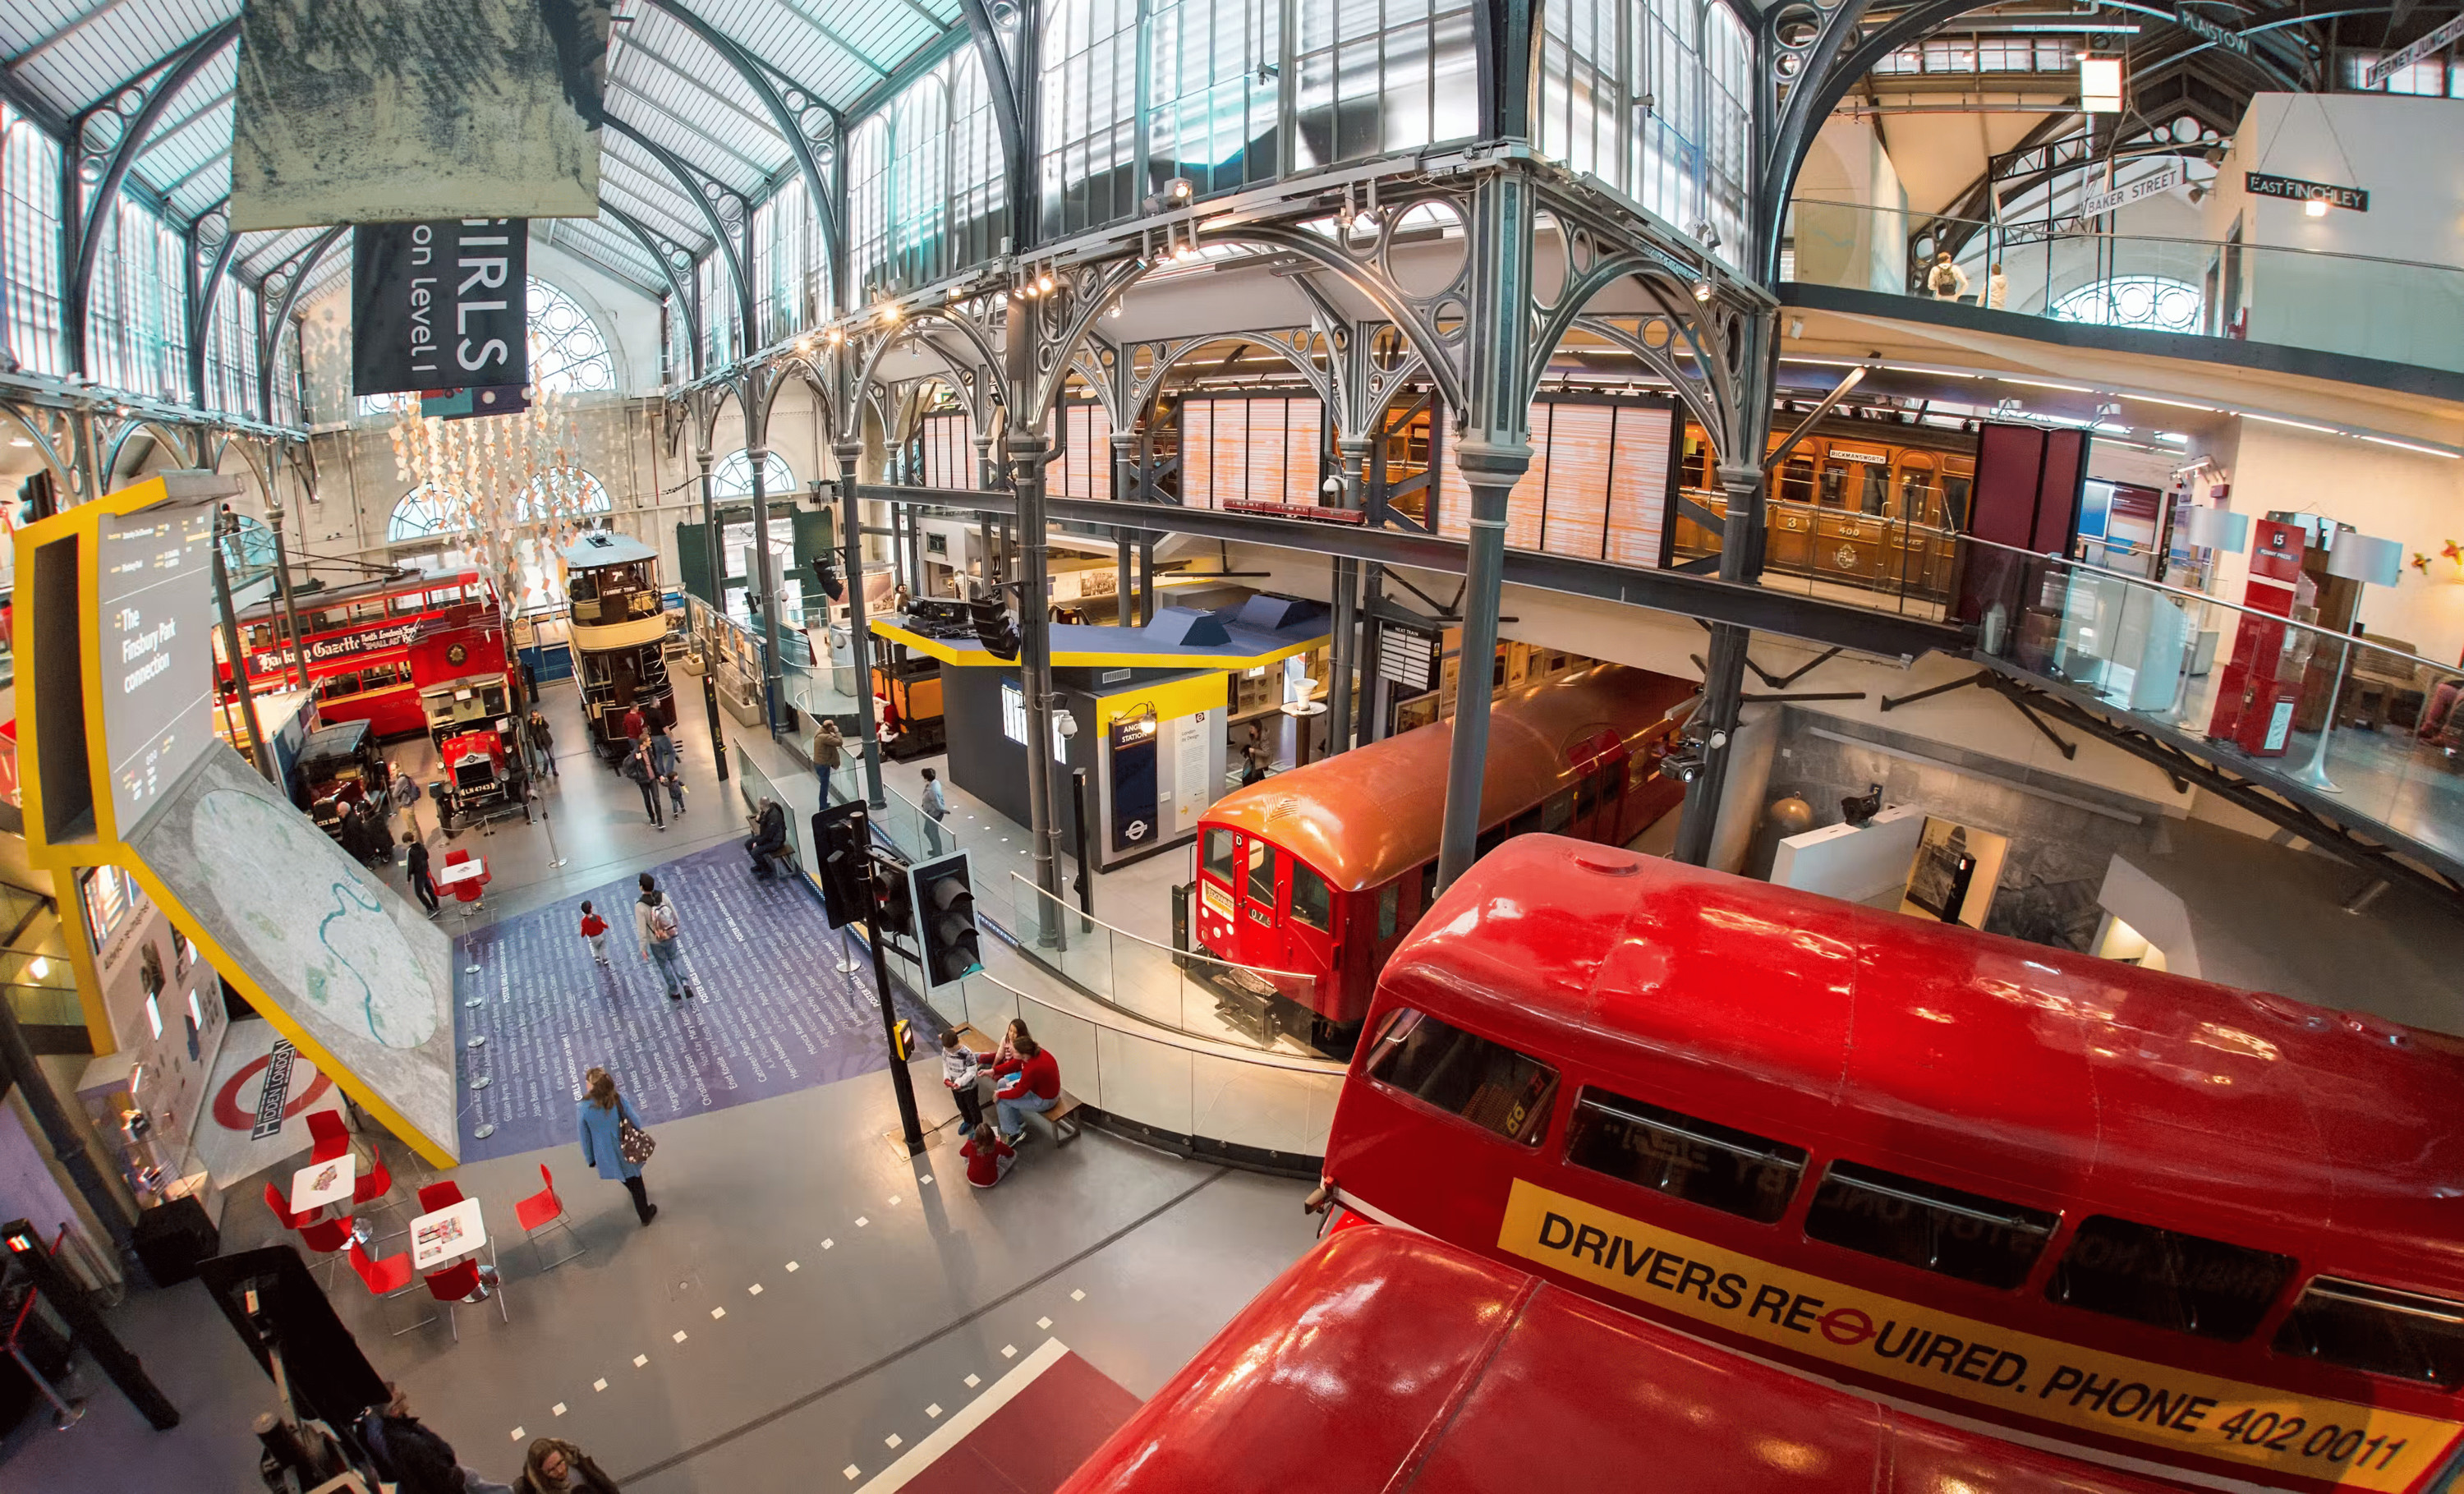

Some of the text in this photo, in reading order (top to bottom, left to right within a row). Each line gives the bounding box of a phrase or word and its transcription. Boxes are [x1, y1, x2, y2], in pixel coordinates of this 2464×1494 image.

[2182, 10, 2249, 54] PLAISTOW
[2414, 15, 2464, 57] JUNCTIO
[2089, 170, 2177, 214] BAKER STREET
[2250, 176, 2362, 207] EAST FINCHLEY
[411, 225, 432, 265] on
[457, 218, 508, 371] IRLS
[1831, 451, 1884, 463] RICKMANSWORTH
[1787, 517, 1798, 528] 3
[1839, 526, 1860, 536] 400
[1893, 536, 1925, 546] DRVER
[2273, 535, 2285, 545] 15
[121, 608, 140, 632] The
[122, 617, 177, 664] Finsbury Park
[313, 636, 361, 657] Gazette
[124, 652, 170, 693] connection
[1122, 731, 1147, 743] STATION
[1181, 729, 1196, 737] London
[1187, 733, 1200, 741] Design
[1236, 834, 1242, 846] D
[726, 917, 736, 927] GIRLS
[732, 926, 744, 941] POSTER
[683, 953, 694, 972] exhibition
[691, 972, 701, 986] GIRLS
[707, 978, 716, 990] Marx
[852, 975, 865, 989] GIRLS
[696, 985, 709, 1003] POSTER
[713, 990, 723, 1001] Enid
[758, 991, 769, 1005] Paola
[806, 974, 851, 1030] Joy Simpson Lucy Skaer
[862, 988, 880, 1007] POSTER
[565, 991, 580, 1032] Victoria Davidson
[607, 996, 616, 1016] Fletcher
[582, 1006, 593, 1027] Dorothy
[613, 1016, 621, 1032] Annie
[668, 1014, 679, 1034] Jackson
[818, 1011, 837, 1034] Maureen
[850, 1011, 863, 1025] Linda
[687, 1025, 697, 1039] Mary
[737, 1006, 769, 1058] Moore Mona Moore
[816, 1031, 830, 1047] Agnes
[535, 1037, 544, 1057] Bourne
[562, 1036, 571, 1050] level
[664, 1038, 675, 1060] Hudson
[694, 1040, 703, 1051] Kay
[696, 1013, 738, 1089] Enid Koelle Mary Koop Nina
[740, 1039, 752, 1055] Mann
[770, 1035, 787, 1059] Nadeem
[801, 1033, 817, 1054] Monica
[511, 1050, 521, 1073] Daphne
[539, 1057, 548, 1073] Olive
[609, 1048, 619, 1069] Edwina
[623, 1050, 633, 1069] Sandra
[685, 1053, 698, 1077] Jackson
[699, 1051, 709, 1066] Nora
[568, 1056, 578, 1083] exhibition
[749, 1055, 766, 1082] Cathleen
[784, 1059, 798, 1078] Henna
[254, 1040, 296, 1138] HIDDEN LONDON
[556, 1075, 565, 1090] Kate
[630, 1069, 641, 1092] Fawkes
[646, 1073, 656, 1090] Ethel
[501, 1083, 511, 1101] Ayres
[529, 1081, 538, 1101] Beales
[572, 1083, 582, 1101] GIRLS
[638, 1092, 647, 1109] Irene
[666, 1082, 681, 1110] Margaret
[695, 1077, 711, 1106] Christine
[532, 1101, 541, 1117] Joan
[1538, 1211, 1747, 1309] DRIVERS
[2040, 1365, 2217, 1432] PHONE
[2218, 1408, 2305, 1451] 402
[2302, 1424, 2408, 1470] 0011
